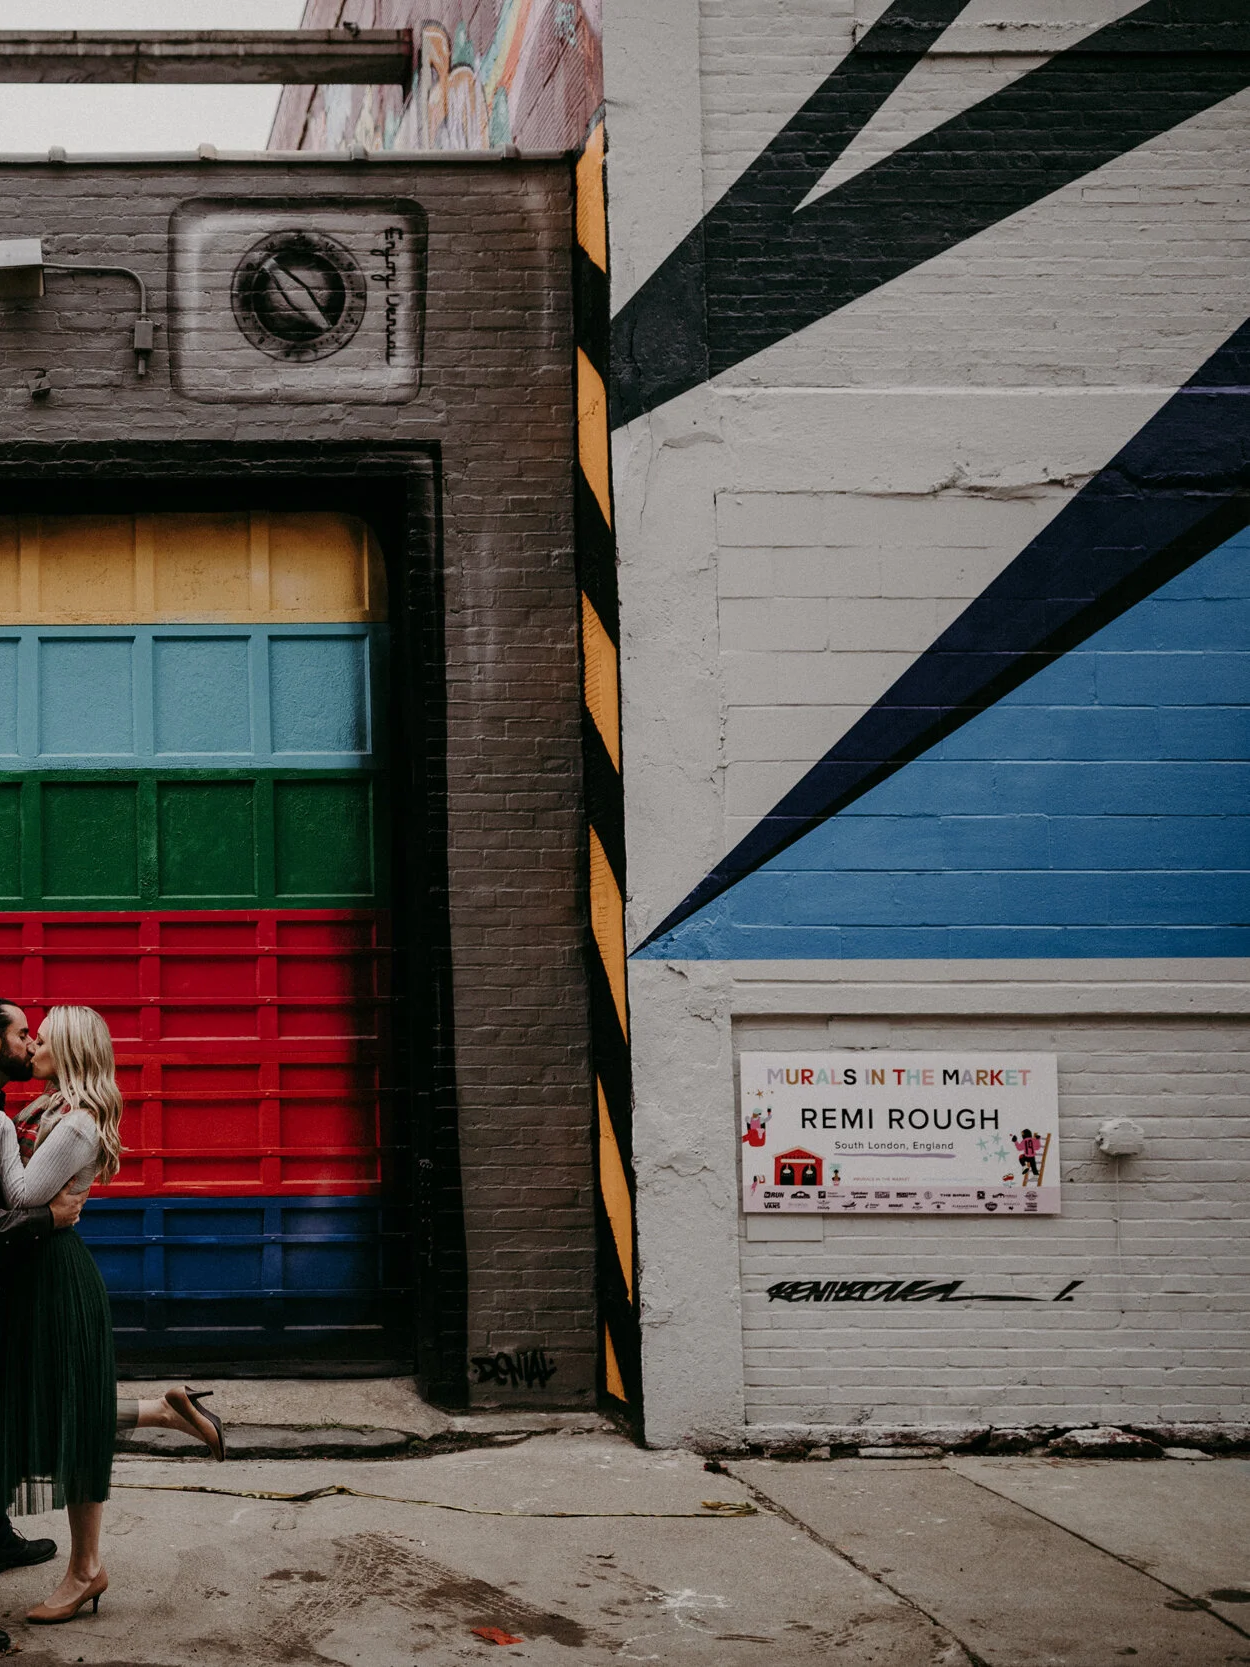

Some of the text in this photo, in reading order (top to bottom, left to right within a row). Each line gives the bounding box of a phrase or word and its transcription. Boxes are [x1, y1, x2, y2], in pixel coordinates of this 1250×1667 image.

[370, 226, 403, 289] Enjoy
[766, 1068, 1032, 1087] MURALS IN THE MARKET
[801, 1108, 1000, 1130] REMI ROUGH
[835, 1141, 954, 1152] South London, England
